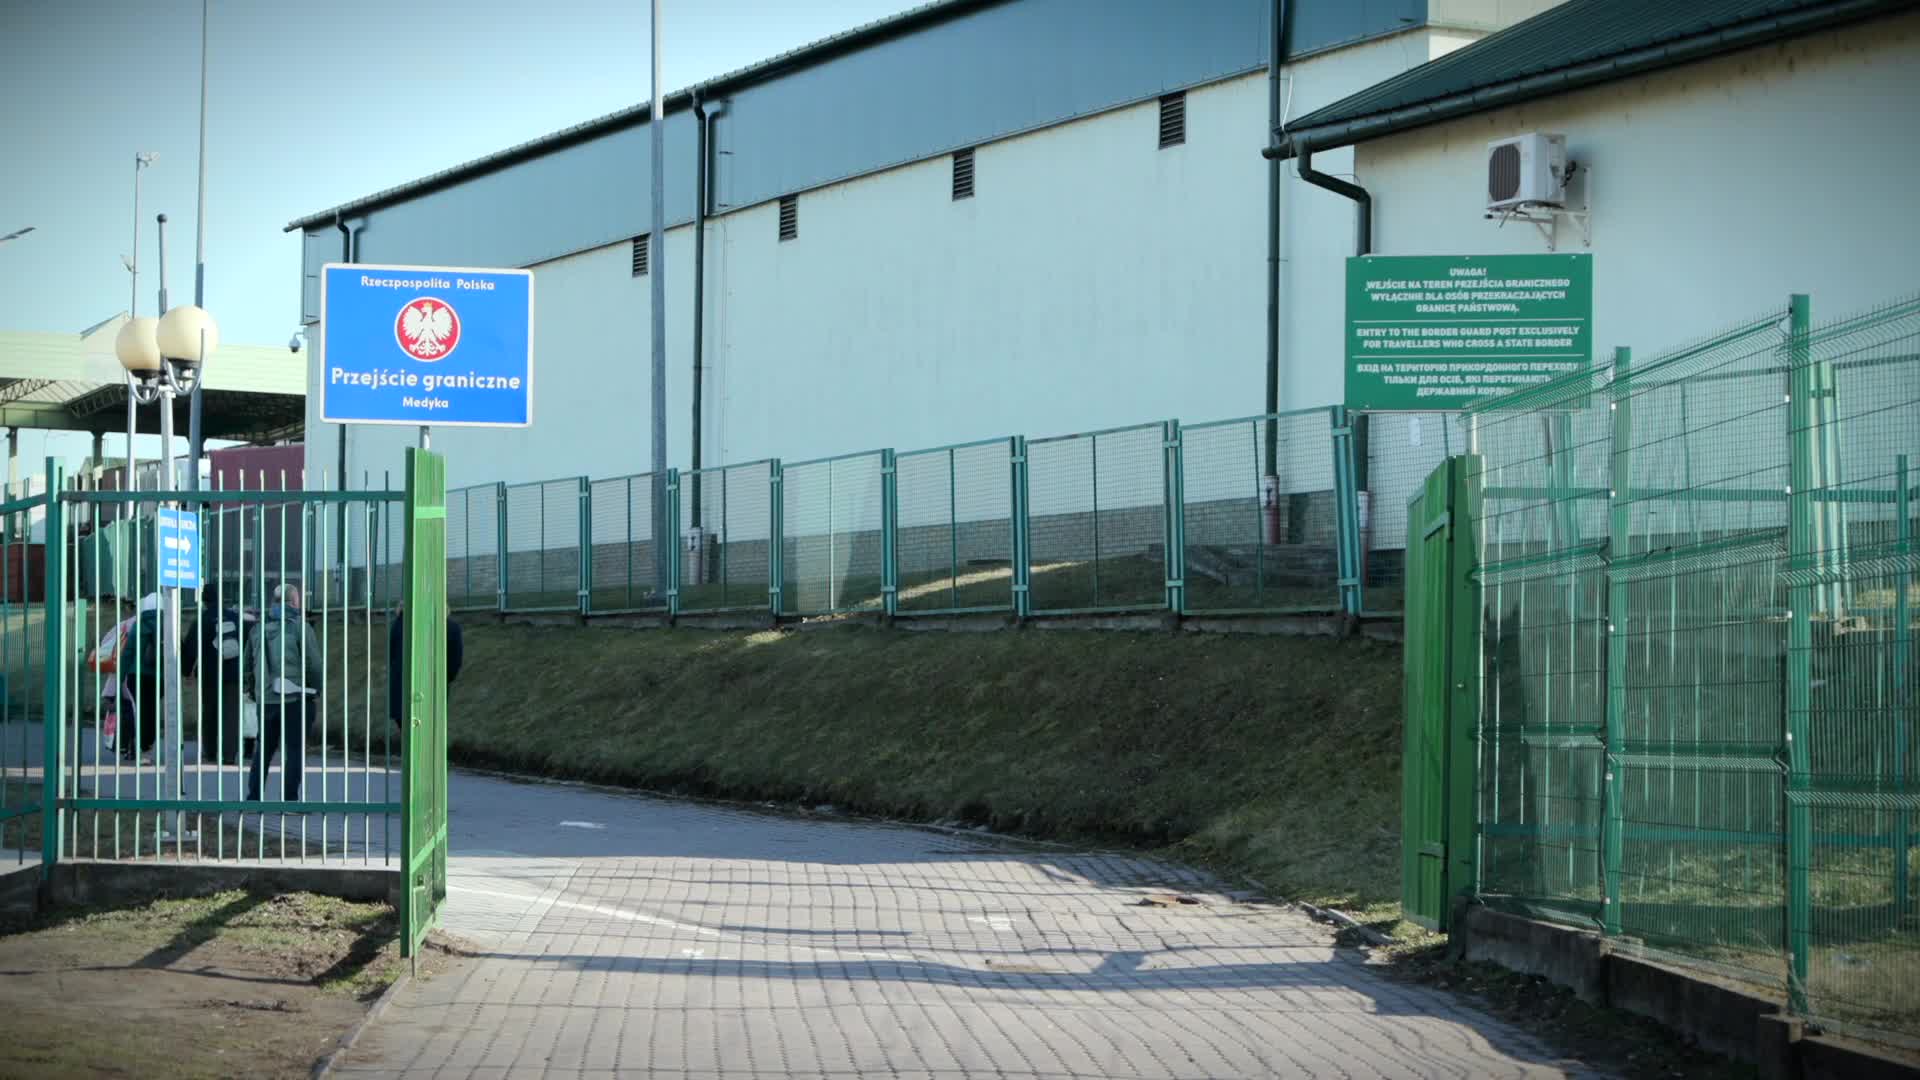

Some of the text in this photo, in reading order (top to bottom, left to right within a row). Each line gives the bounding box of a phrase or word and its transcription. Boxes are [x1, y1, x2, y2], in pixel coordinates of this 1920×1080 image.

[1450, 268, 1487, 276] UWAGA!
[361, 276, 495, 290] Rzeczpospolita Polska
[1367, 278, 1570, 290] WEJŚCIE NA TEREN PRZEJŚCIA GRANICZNEGO
[1371, 289, 1565, 302] WYŁĄCZNIE DLA OSÓB PRZEKRACZAJĄCYCH
[1416, 304, 1456, 314] GRANICĘ
[1356, 326, 1579, 337] ENTRY TO THE BORDER GUARD POST EXCLUSIVELY
[1363, 338, 1572, 348] FOR TRAVELLERS WHO CROSS A STATE BORDER
[1356, 364, 1379, 374] ВХІД
[1381, 364, 1394, 372] НА
[1395, 363, 1448, 372] ТЕРИТОРІЮ
[331, 368, 520, 391] Przejście graniczne
[1383, 376, 1417, 385] ТІЛЬКИ
[1418, 375, 1439, 386] ДЛЯ
[1465, 375, 1481, 384] ЯКІ
[1416, 385, 1475, 398] ДЕРЖАВНИЙ
[403, 397, 449, 409] Medyka
